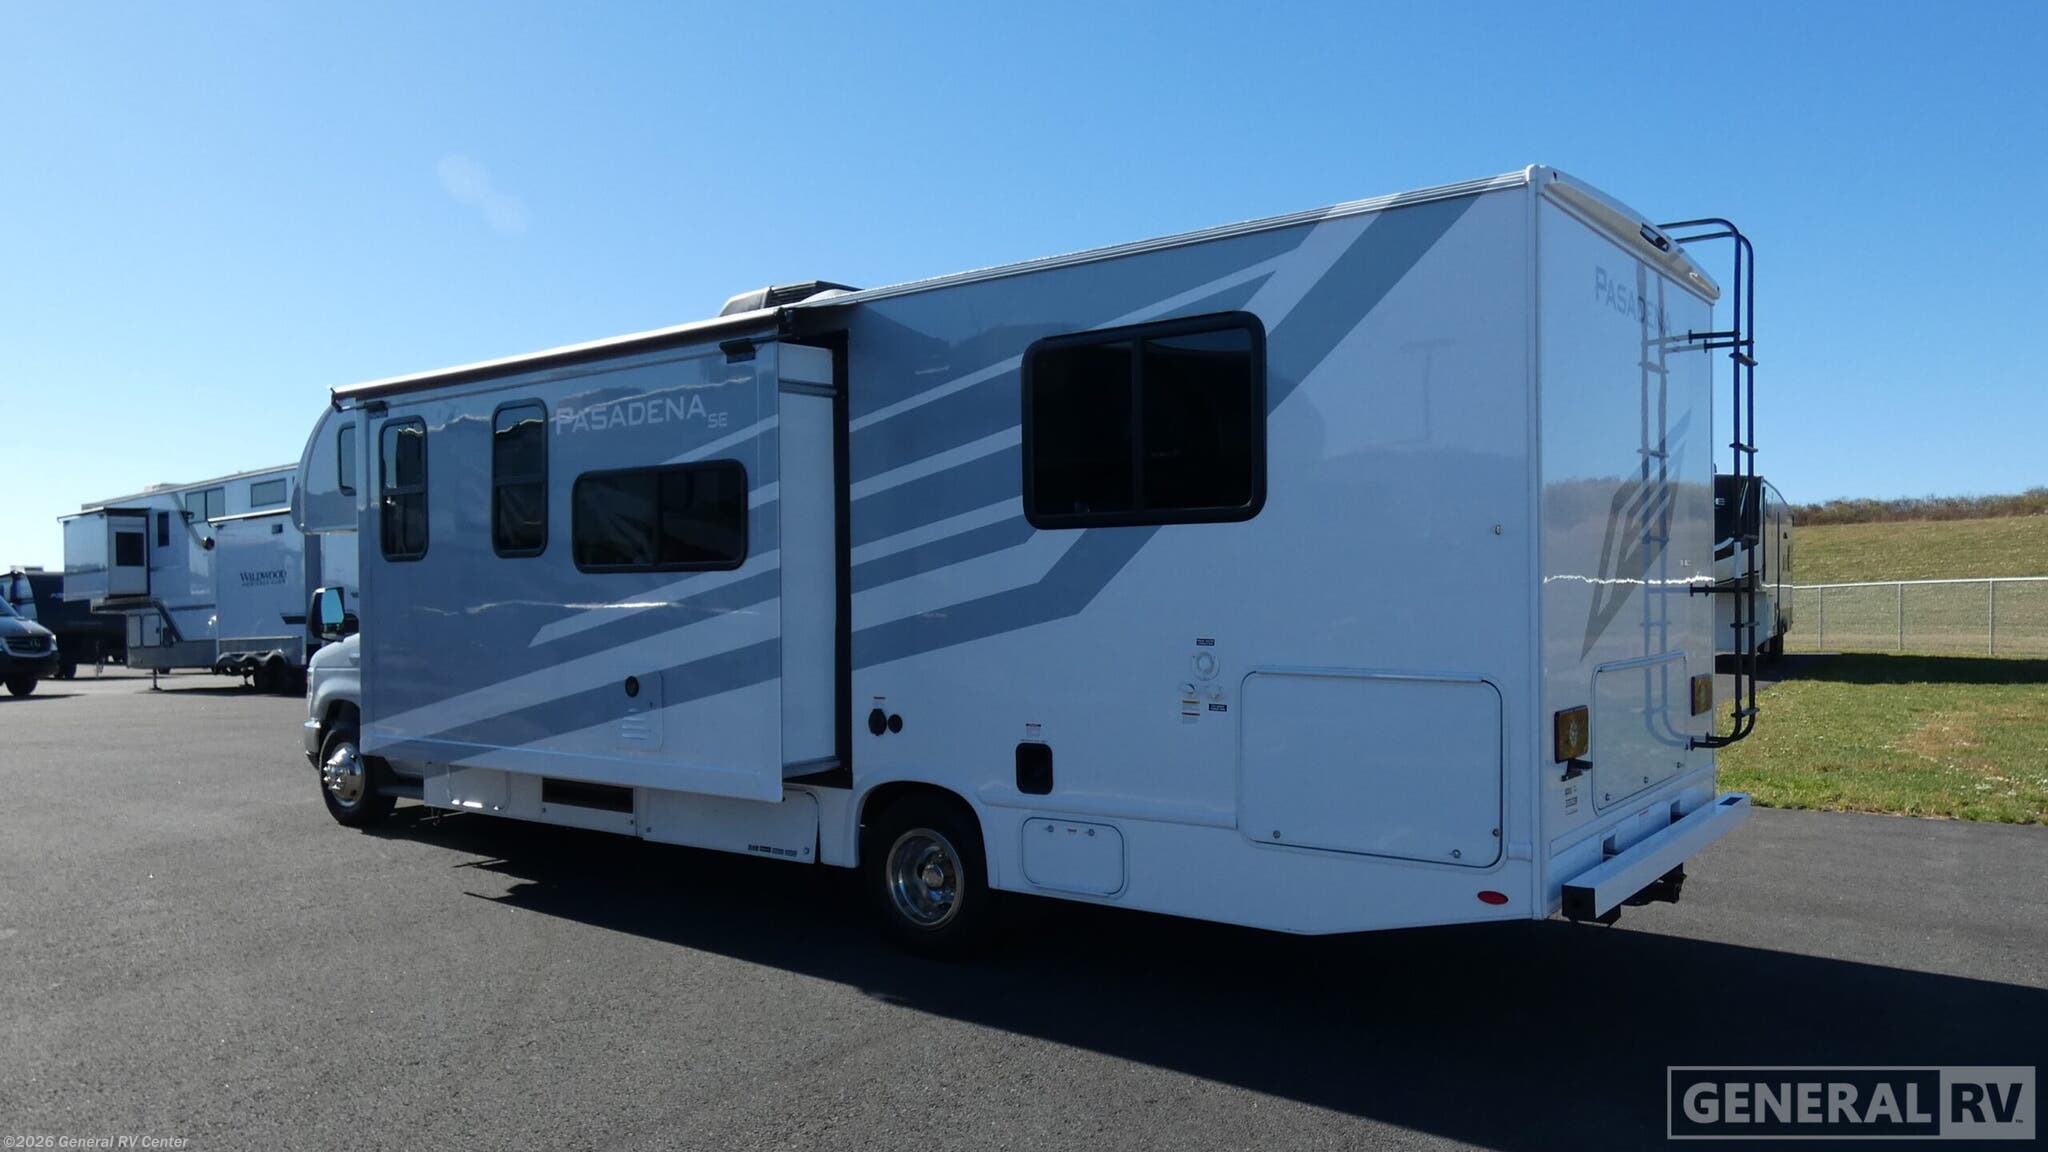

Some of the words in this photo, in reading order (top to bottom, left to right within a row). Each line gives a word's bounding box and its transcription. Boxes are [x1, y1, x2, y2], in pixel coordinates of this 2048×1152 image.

[1595, 266, 1672, 336] PASADENA
[555, 394, 706, 436] PASADENA
[707, 411, 728, 428] SE
